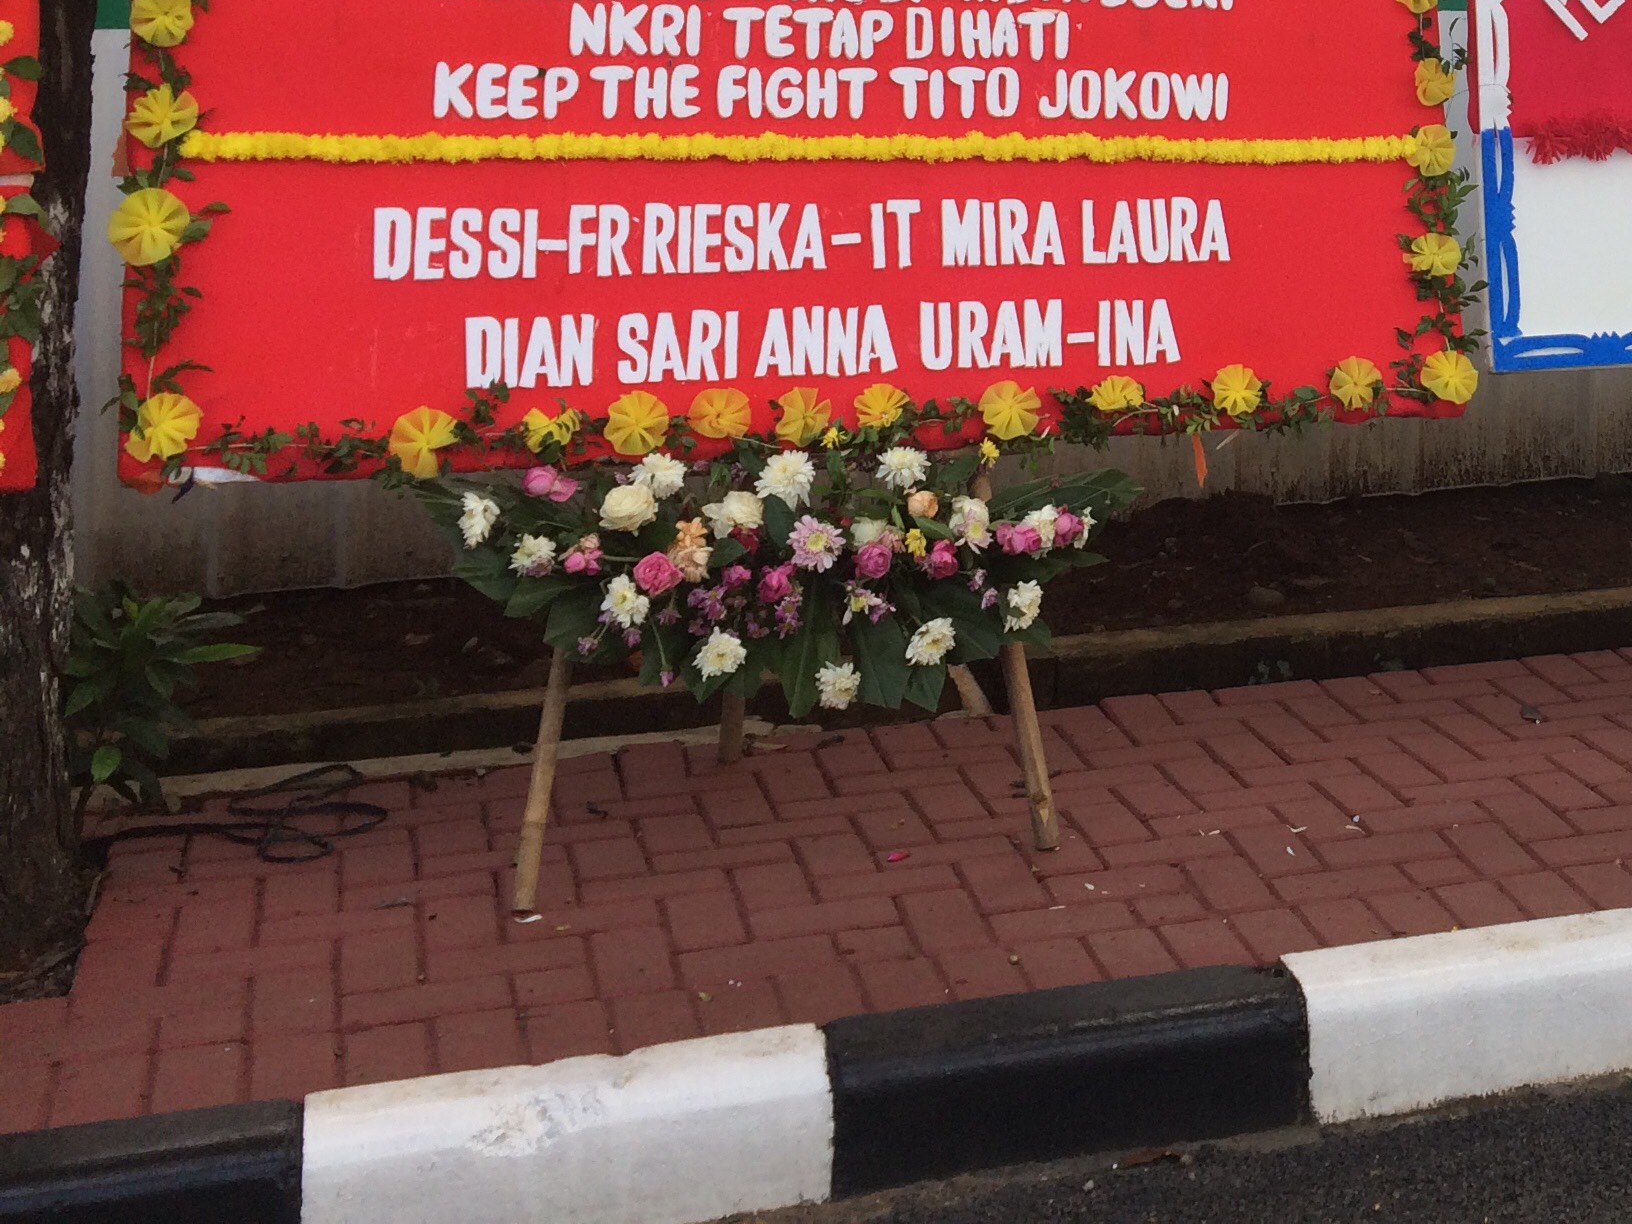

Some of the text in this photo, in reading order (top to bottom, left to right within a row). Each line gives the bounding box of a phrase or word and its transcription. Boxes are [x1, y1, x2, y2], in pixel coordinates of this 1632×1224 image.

[568, 2, 702, 57] NKRI
[722, 4, 895, 61] TETAP
[433, 61, 1230, 122] KEEP THE FIGHT TITO JOKOWI
[941, 199, 1066, 267] MIRA
[1081, 197, 1232, 265] LAURA
[464, 313, 596, 390] DIAN
[616, 309, 740, 385] SARI
[754, 305, 898, 379] ANNA
